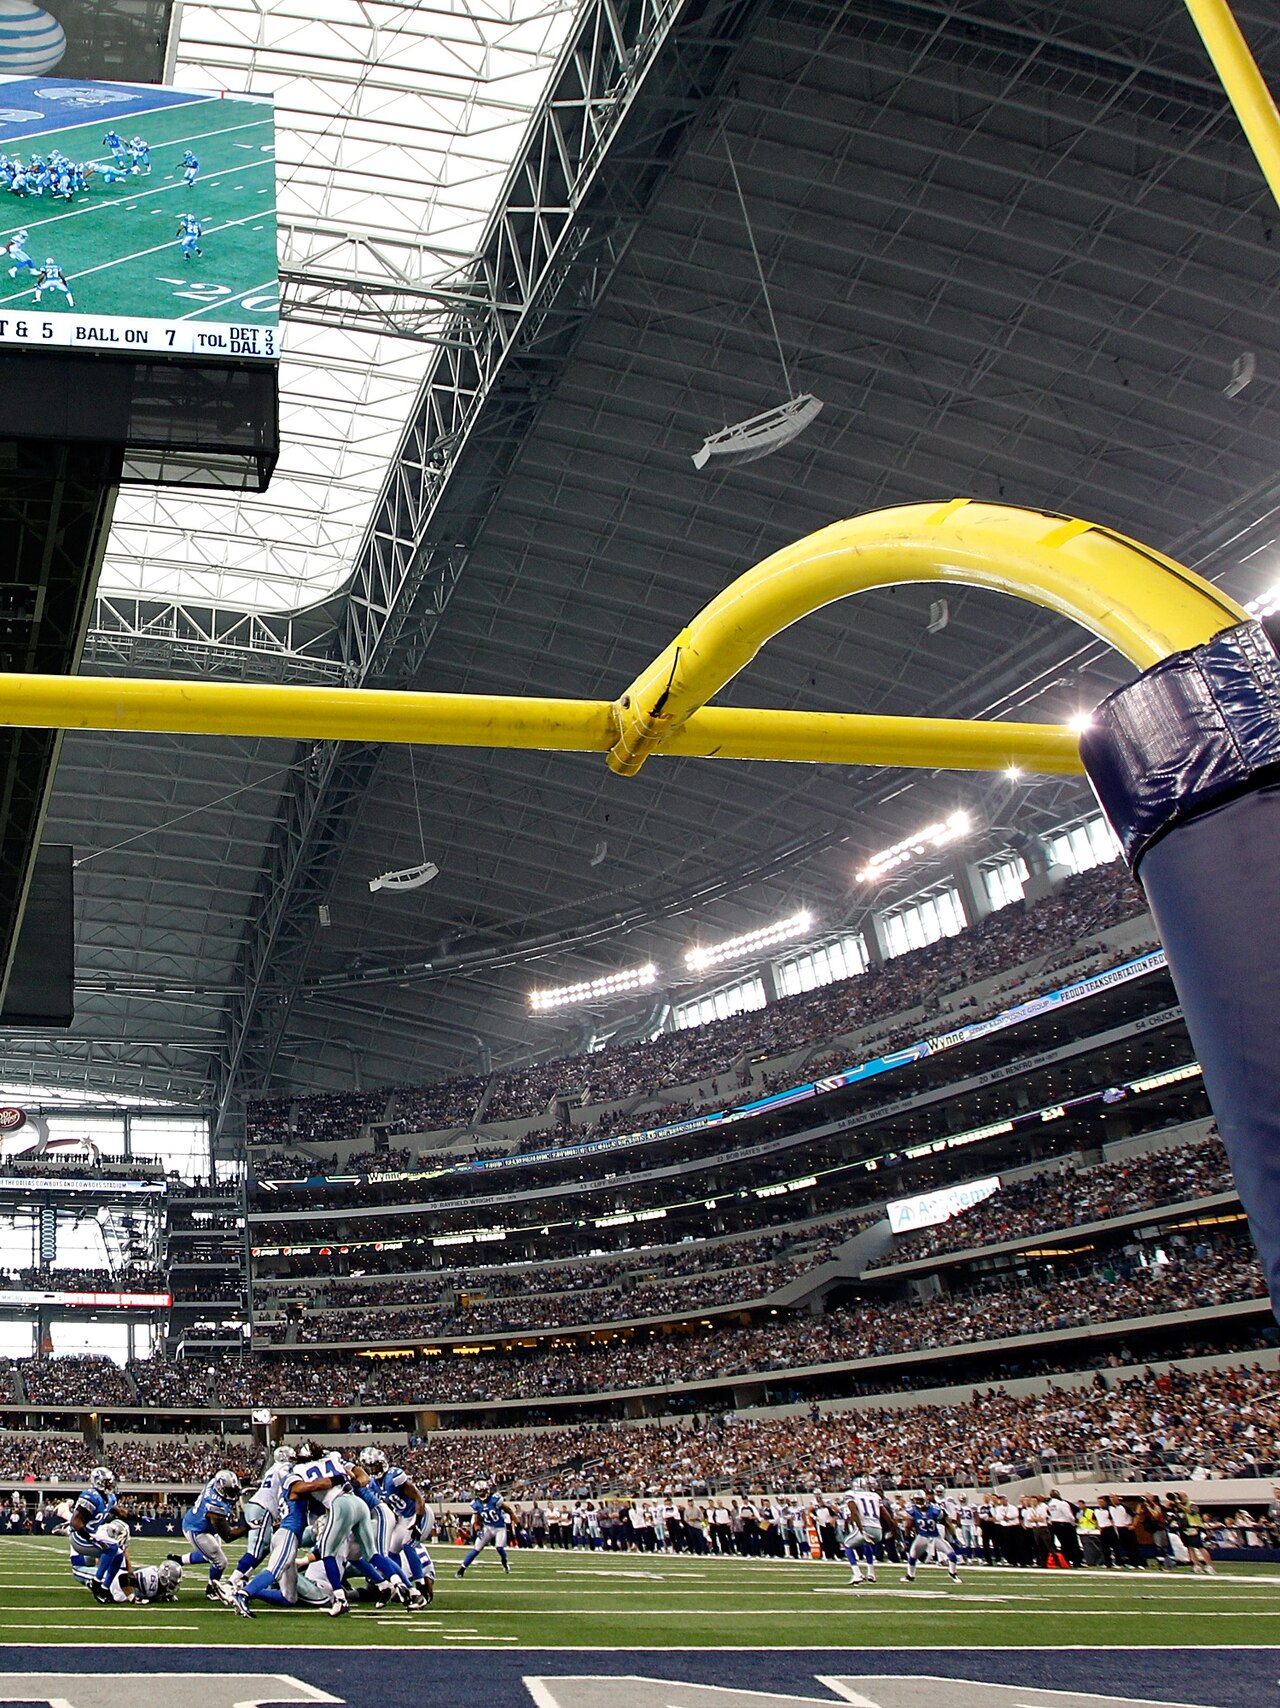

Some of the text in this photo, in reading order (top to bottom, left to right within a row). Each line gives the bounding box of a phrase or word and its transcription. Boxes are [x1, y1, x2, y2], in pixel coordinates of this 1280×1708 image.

[44, 266, 60, 279] 23
[15, 321, 28, 337] &
[42, 322, 54, 339] 5
[76, 326, 176, 346] BALL ON 7
[229, 327, 274, 342] DET 3
[197, 333, 227, 348] TOL
[229, 340, 274, 356] DAL 3
[1086, 960, 1148, 993] TRANSPORTATION
[1148, 1012, 1175, 1026] CHUCK
[926, 1029, 966, 1051] Wynne
[1005, 1061, 1033, 1076] RENFRO
[869, 1108, 890, 1121] WHITE
[740, 1146, 762, 1159] HAYES
[15, 1179, 35, 1187] DALLAS
[35, 1180, 63, 1188] COWBOYS
[75, 1181, 102, 1189] COWBOYS
[102, 1182, 127, 1190] STADIUM
[439, 1199, 469, 1208] RAYFIELD
[469, 1196, 495, 1205] WRIGHT
[260, 1241, 403, 1257] pepsi pepsi pepsi
[859, 1497, 880, 1519] 11
[480, 1509, 499, 1524] 26
[916, 1519, 937, 1533] 23
